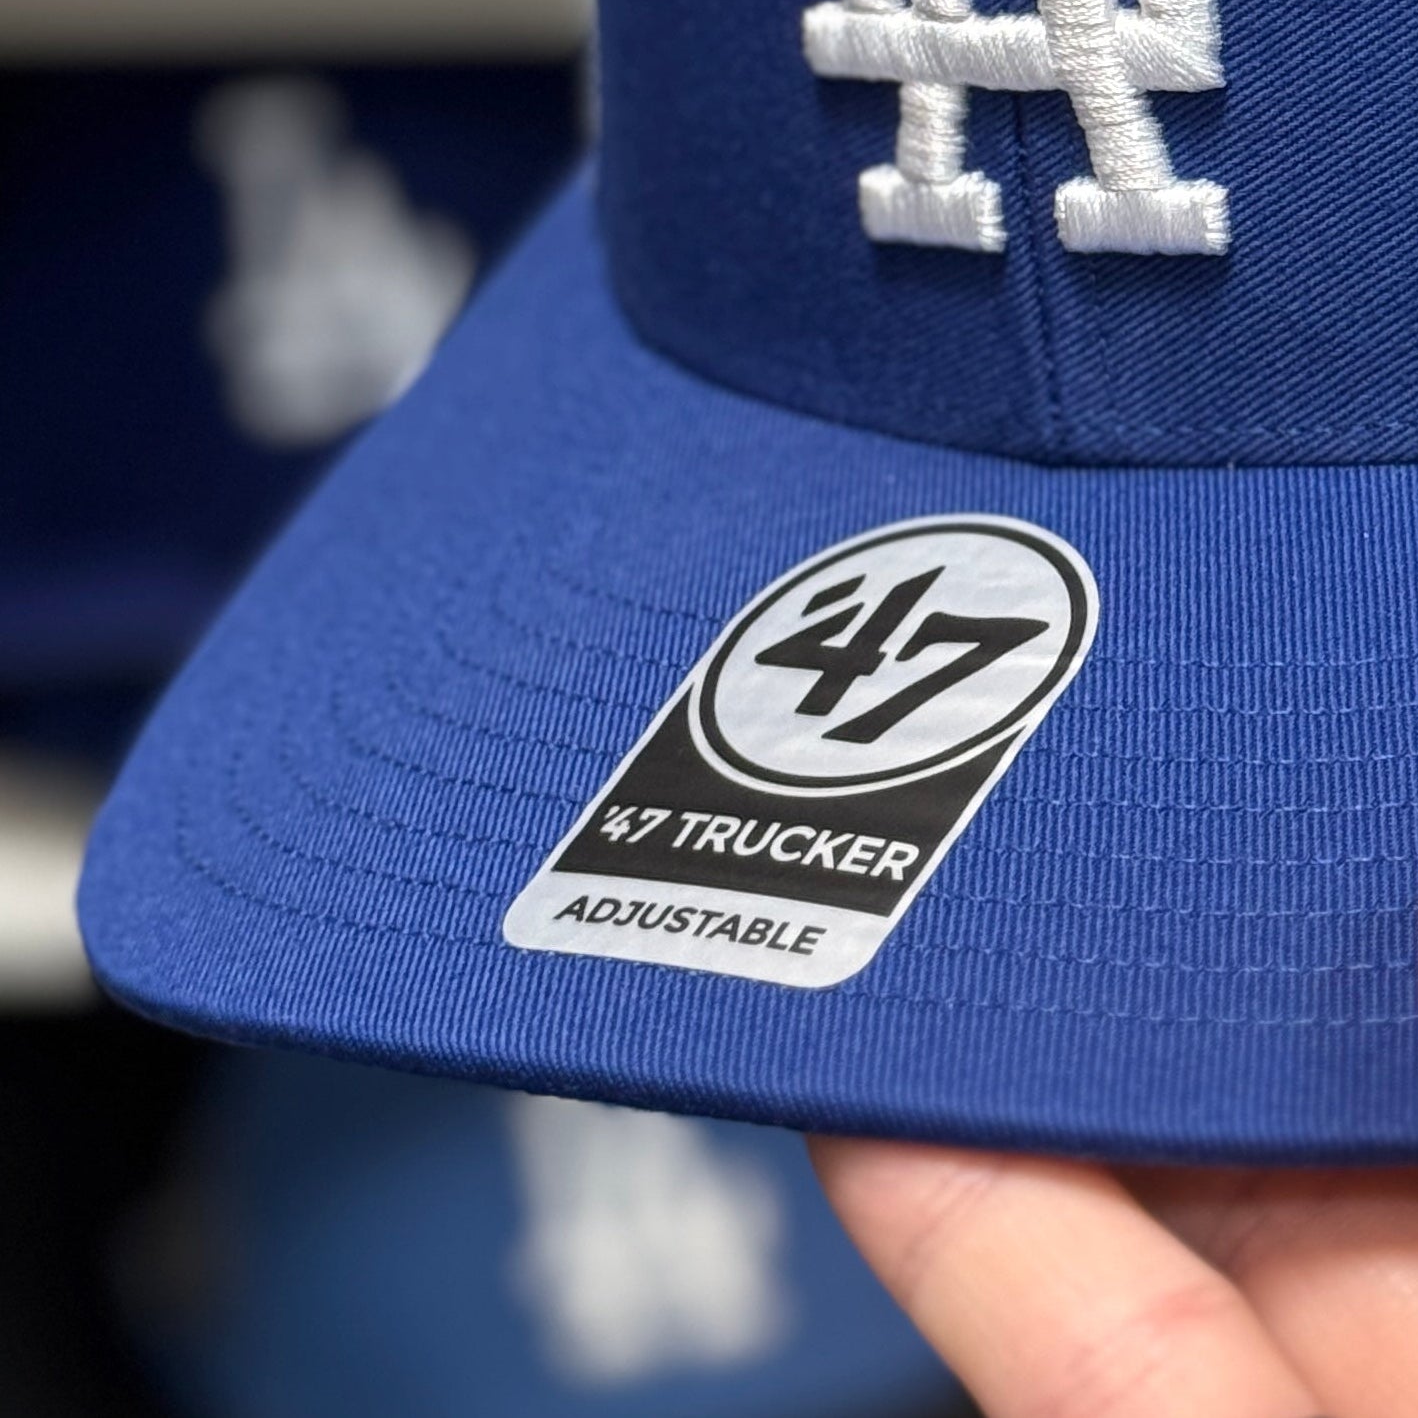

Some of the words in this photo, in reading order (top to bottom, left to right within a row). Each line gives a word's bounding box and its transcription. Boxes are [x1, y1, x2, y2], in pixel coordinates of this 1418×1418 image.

[754, 565, 1050, 744] '47
[598, 805, 666, 843] '47
[673, 812, 920, 882] TRUCKER
[554, 894, 827, 956] ADJUSTABLE
